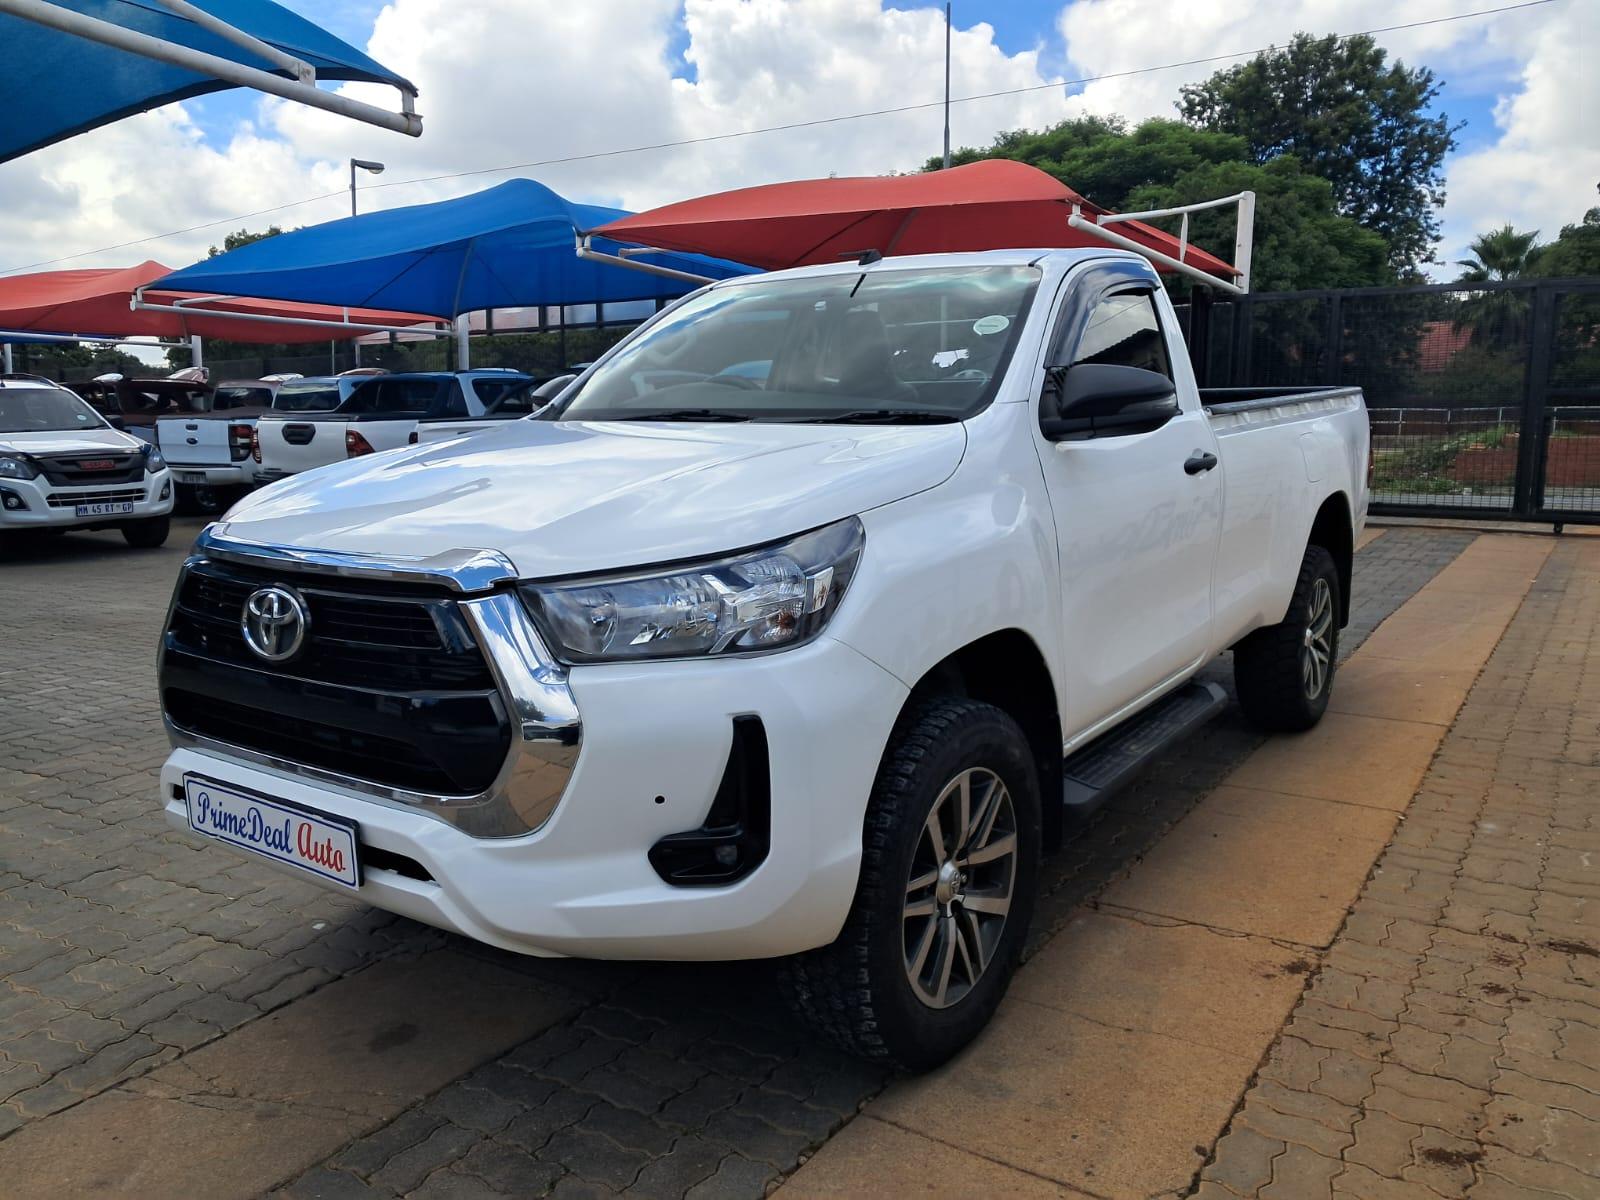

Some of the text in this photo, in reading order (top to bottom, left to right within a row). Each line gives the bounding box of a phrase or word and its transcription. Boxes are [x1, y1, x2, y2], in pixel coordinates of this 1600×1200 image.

[122, 502, 132, 511] GP
[198, 791, 346, 872] PrimeDeal Auto
